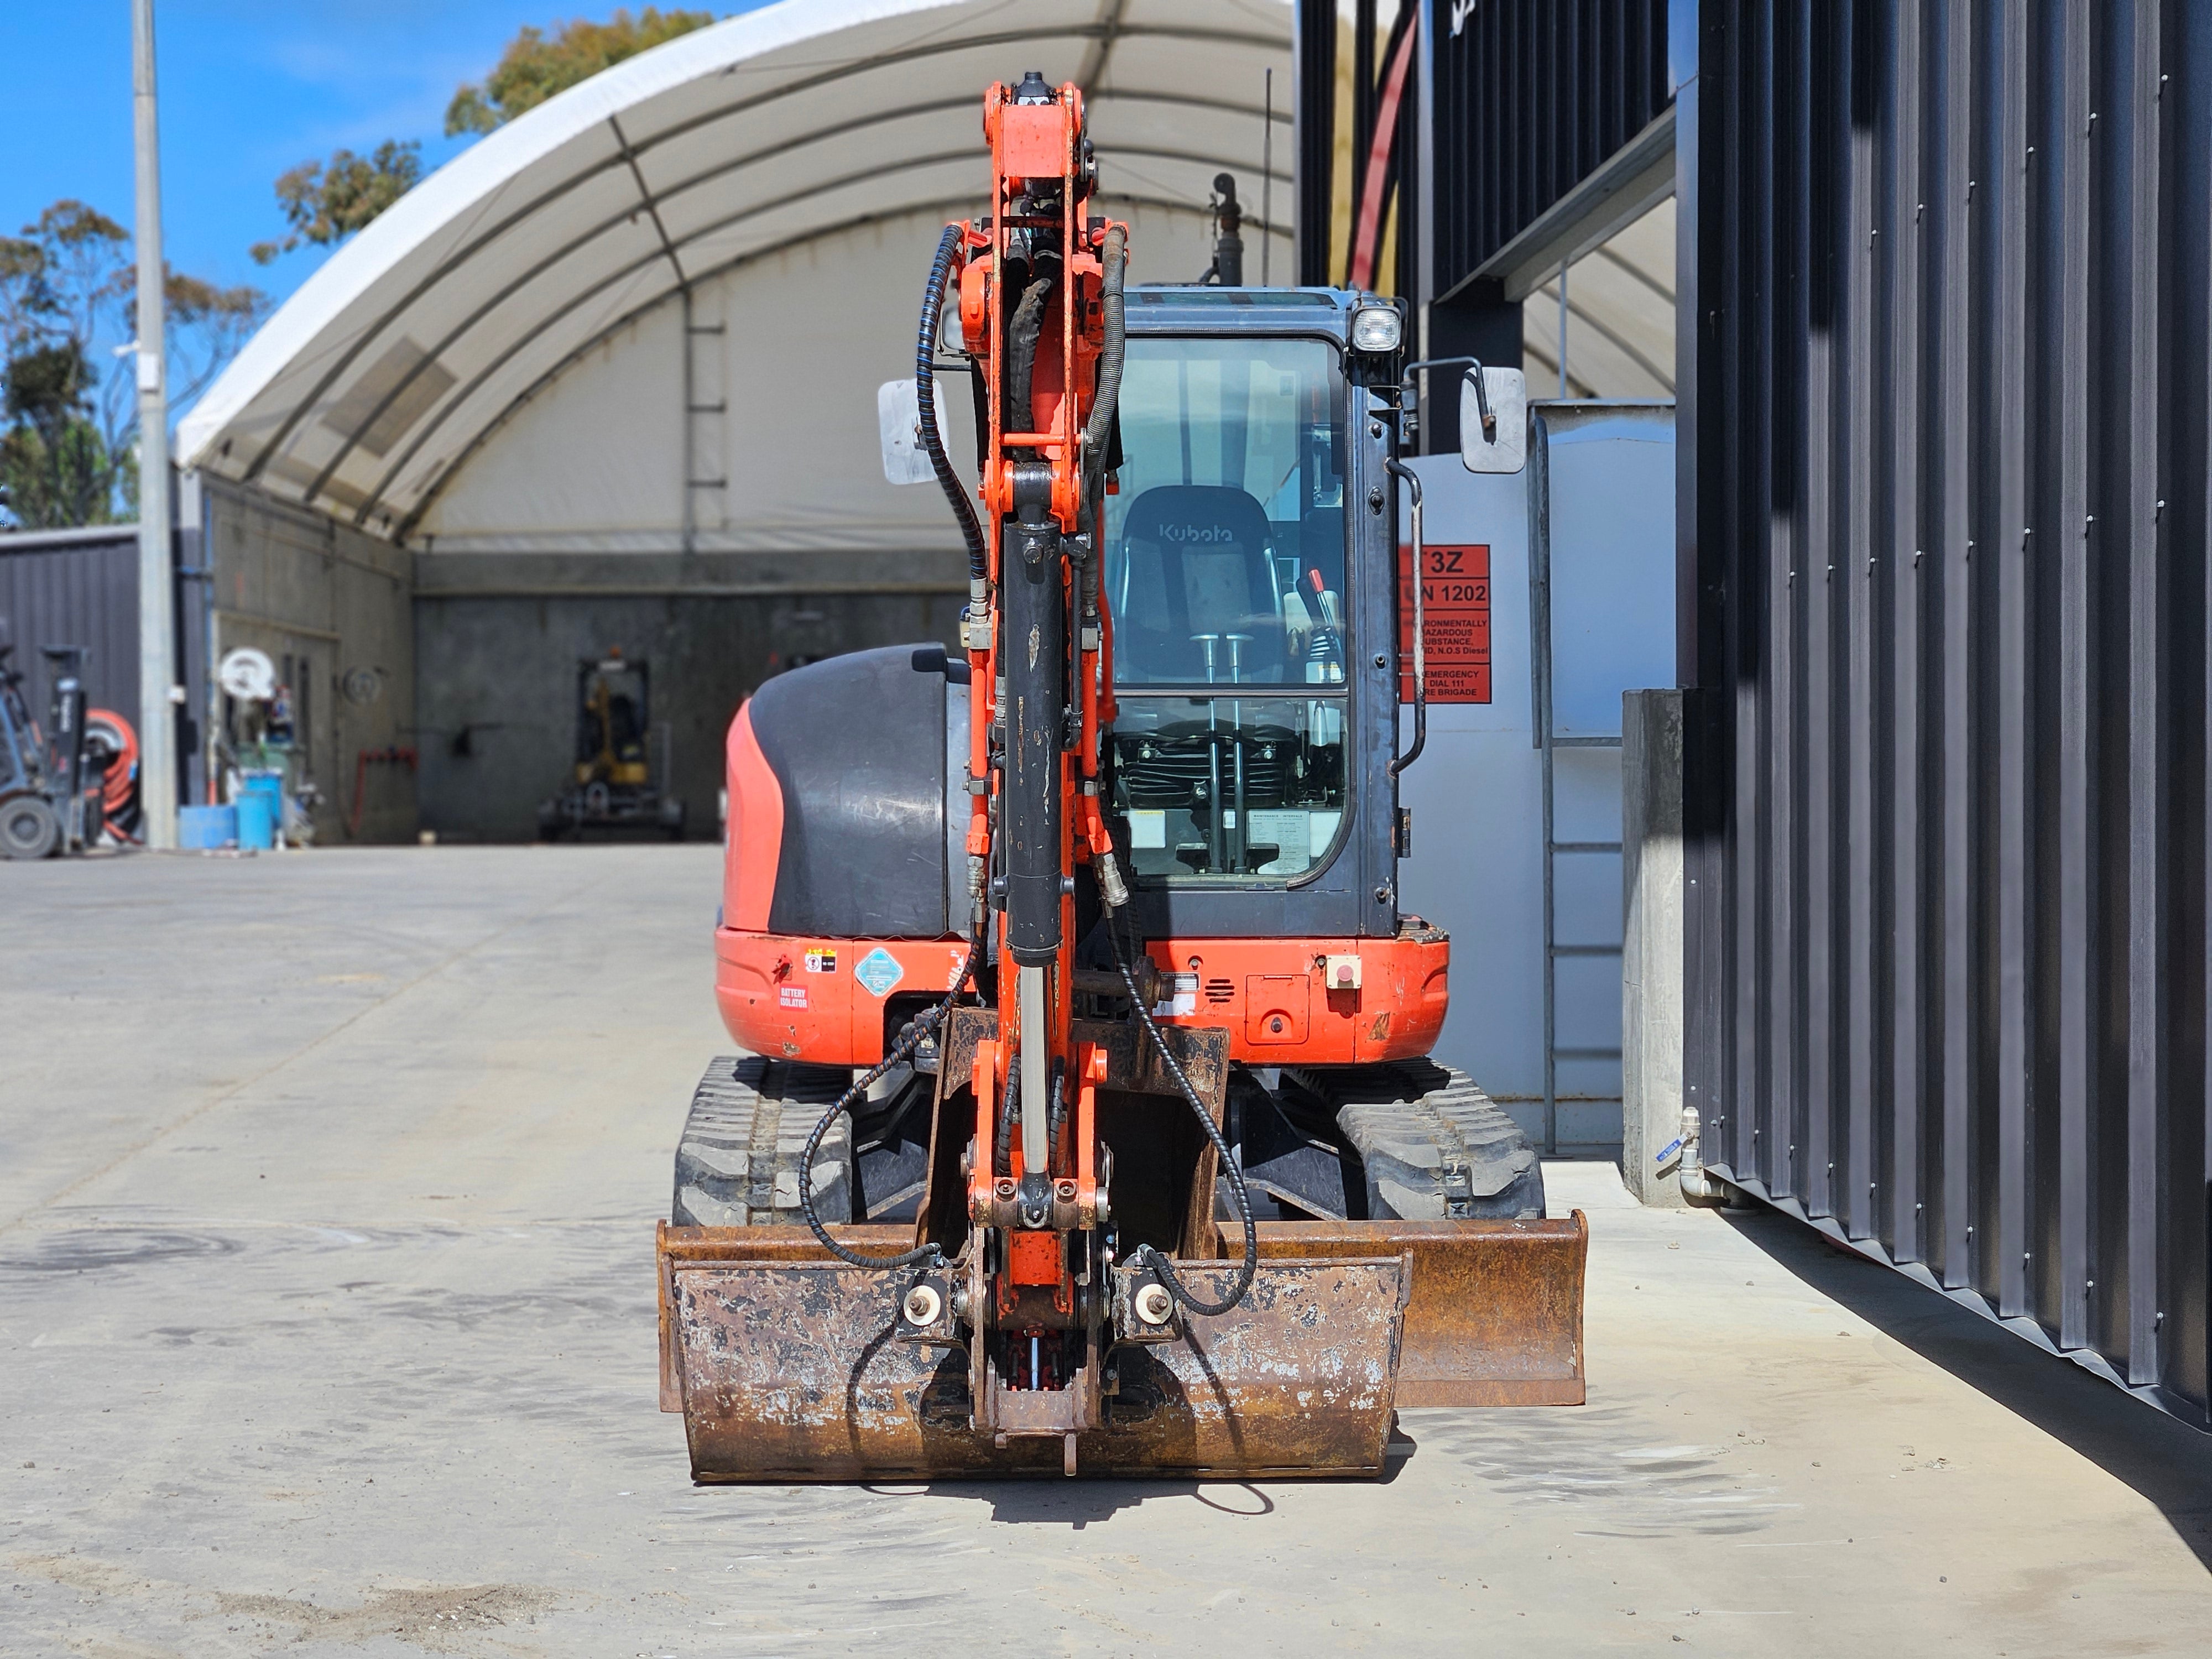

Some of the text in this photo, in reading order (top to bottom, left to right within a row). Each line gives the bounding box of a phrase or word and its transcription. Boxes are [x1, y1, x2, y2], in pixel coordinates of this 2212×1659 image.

[1159, 524, 1233, 541] Kubota
[1431, 551, 1464, 573] 3Z
[1442, 585, 1486, 601] 1202
[1423, 638, 1474, 646] UBSTANCE,
[1438, 646, 1460, 655] N.O.S
[781, 988, 806, 998] BATTERY
[780, 997, 807, 1009] ISOLATOR
